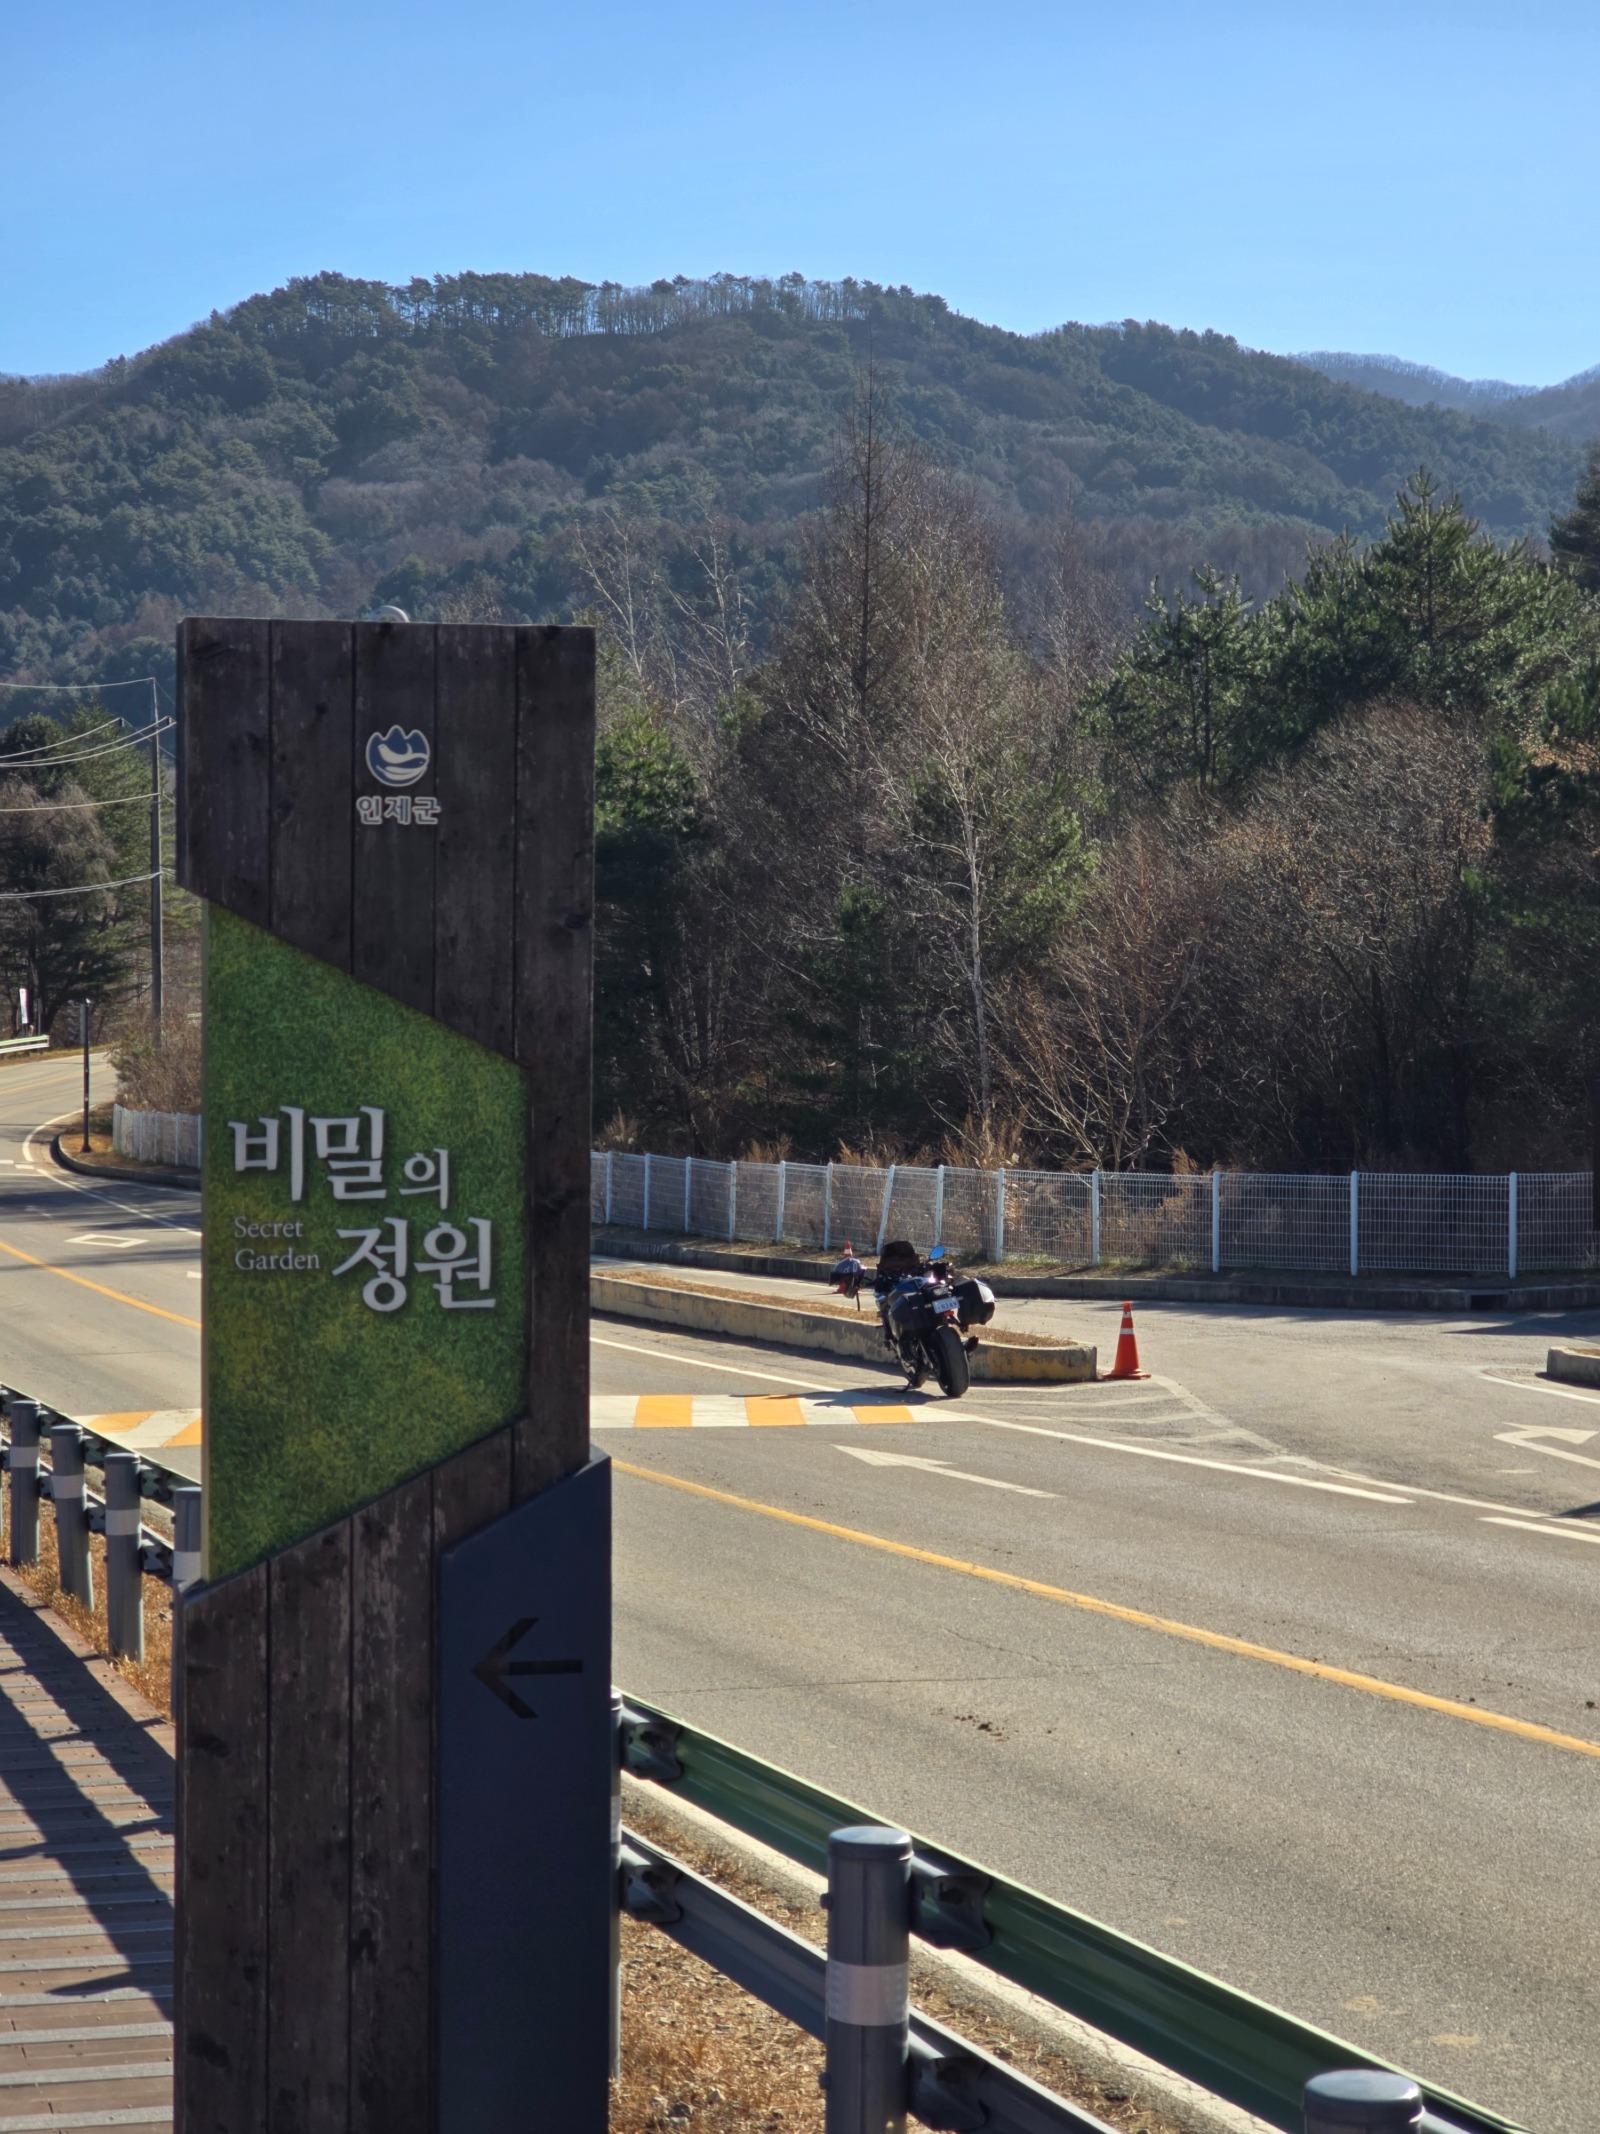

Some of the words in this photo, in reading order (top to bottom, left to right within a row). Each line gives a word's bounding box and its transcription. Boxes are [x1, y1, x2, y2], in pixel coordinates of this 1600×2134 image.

[356, 796, 442, 825] 인제군
[228, 1106, 449, 1210] 비밀의
[234, 1216, 303, 1239] Secret
[235, 1247, 320, 1271] Garden
[331, 1217, 496, 1312] 정원
